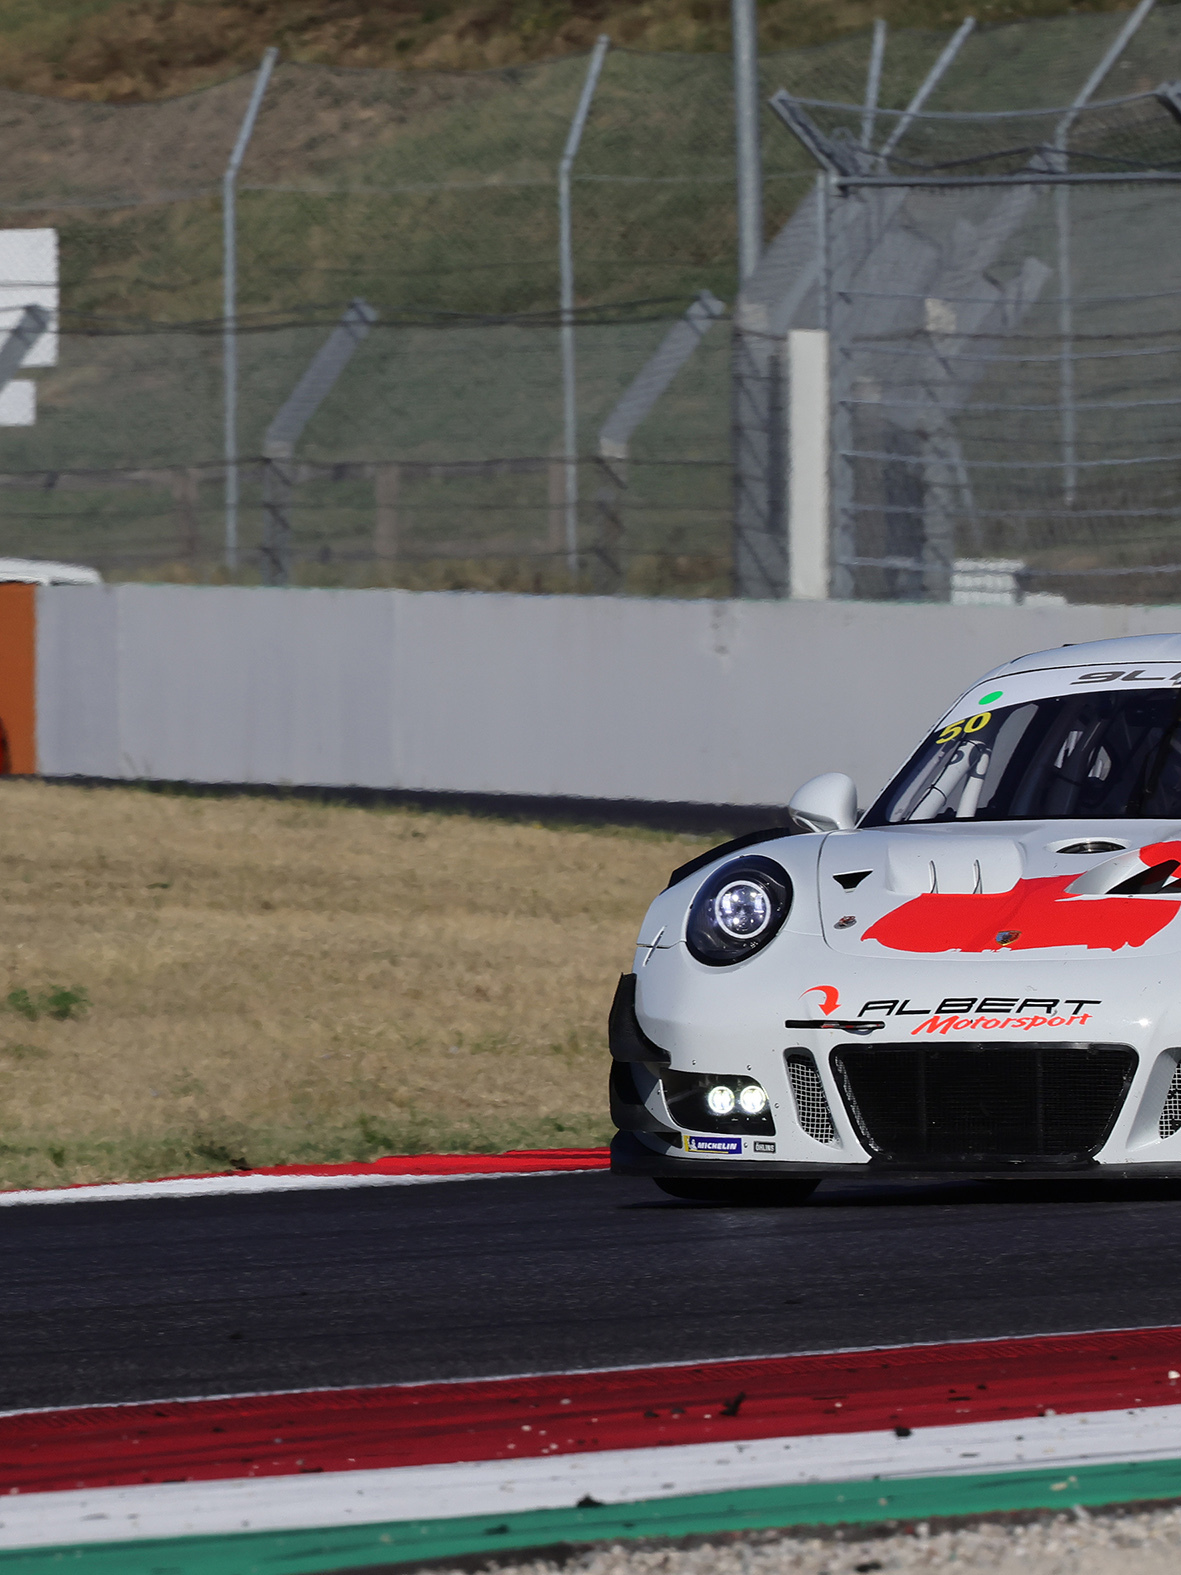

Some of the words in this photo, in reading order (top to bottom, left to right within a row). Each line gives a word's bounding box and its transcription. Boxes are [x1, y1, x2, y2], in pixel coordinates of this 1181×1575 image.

[935, 711, 992, 745] 50
[856, 997, 1102, 1018] ALBERT
[910, 1013, 1093, 1036] Motorsport
[697, 1142, 738, 1150] MICHELIN
